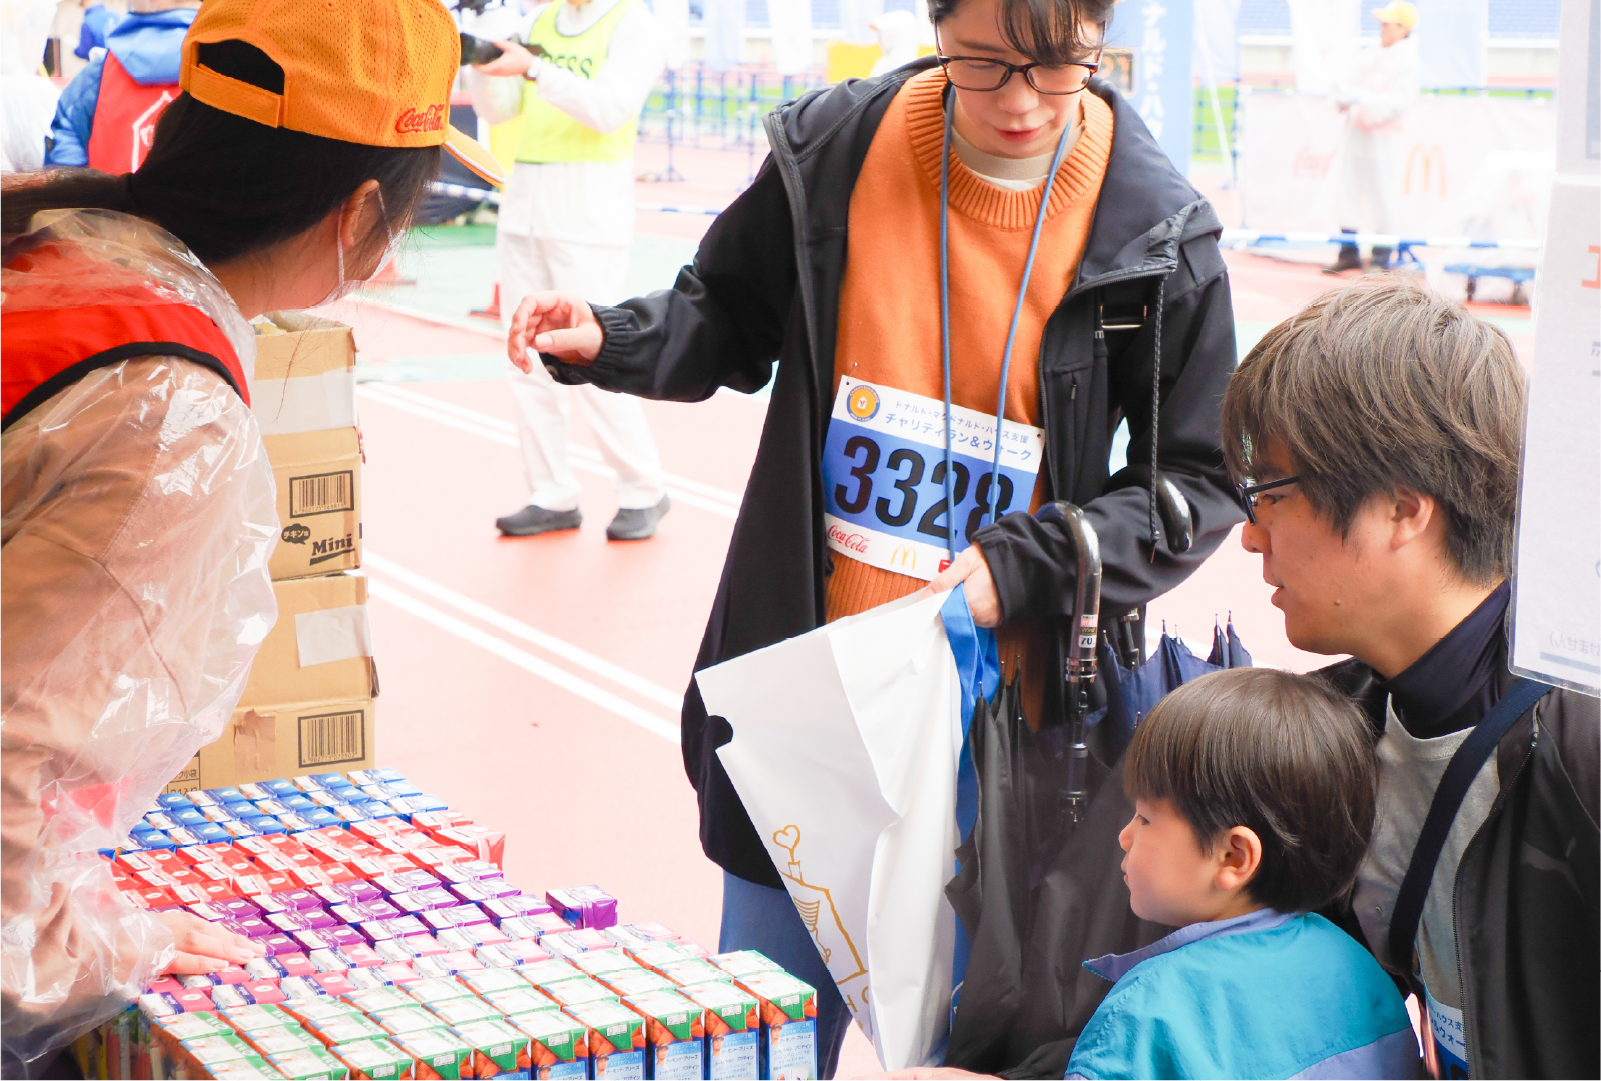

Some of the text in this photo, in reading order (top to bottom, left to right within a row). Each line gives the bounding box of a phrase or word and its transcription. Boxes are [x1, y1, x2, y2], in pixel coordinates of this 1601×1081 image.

[895, 400, 1029, 444] ドナルド・マドナルド・ハス支援
[834, 435, 1014, 545] 3328
[311, 533, 353, 556] Mini
